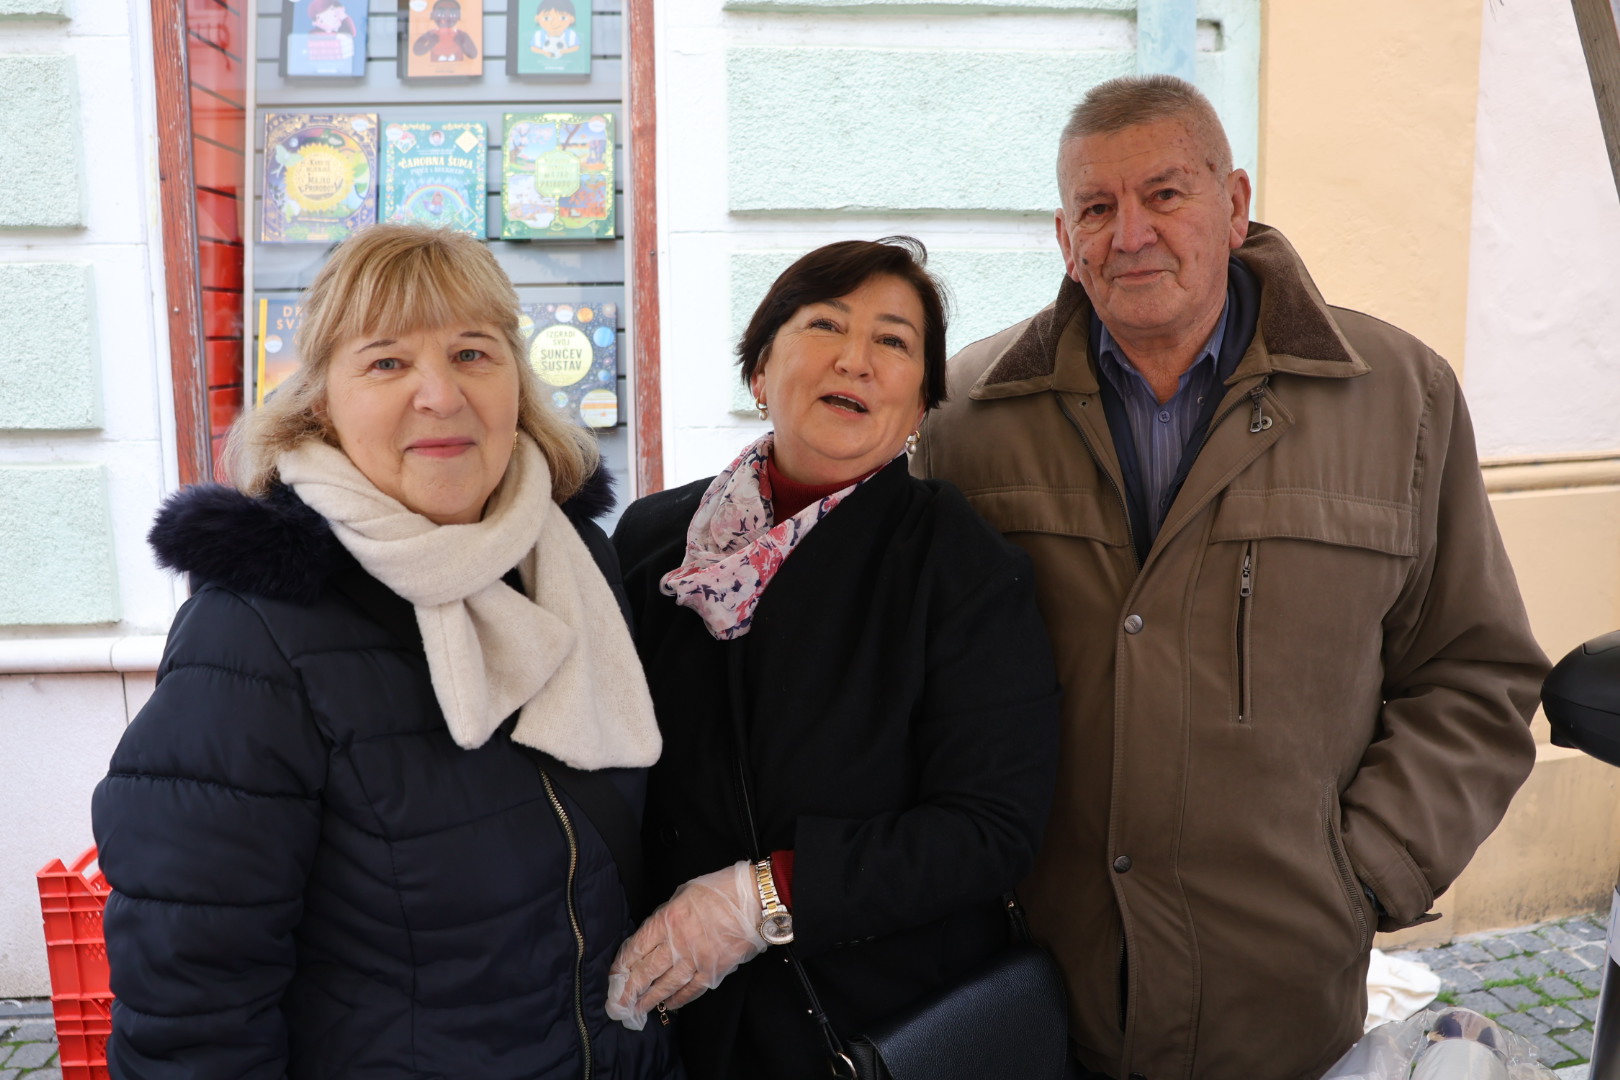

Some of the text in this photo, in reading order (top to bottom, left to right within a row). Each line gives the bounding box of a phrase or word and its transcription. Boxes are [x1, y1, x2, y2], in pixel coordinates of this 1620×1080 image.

[401, 154, 474, 169] ČAROBNA ŠUMA
[552, 338, 570, 346] SVOJ
[540, 347, 583, 360] SUNČEV
[541, 360, 582, 371] SUSTAV
